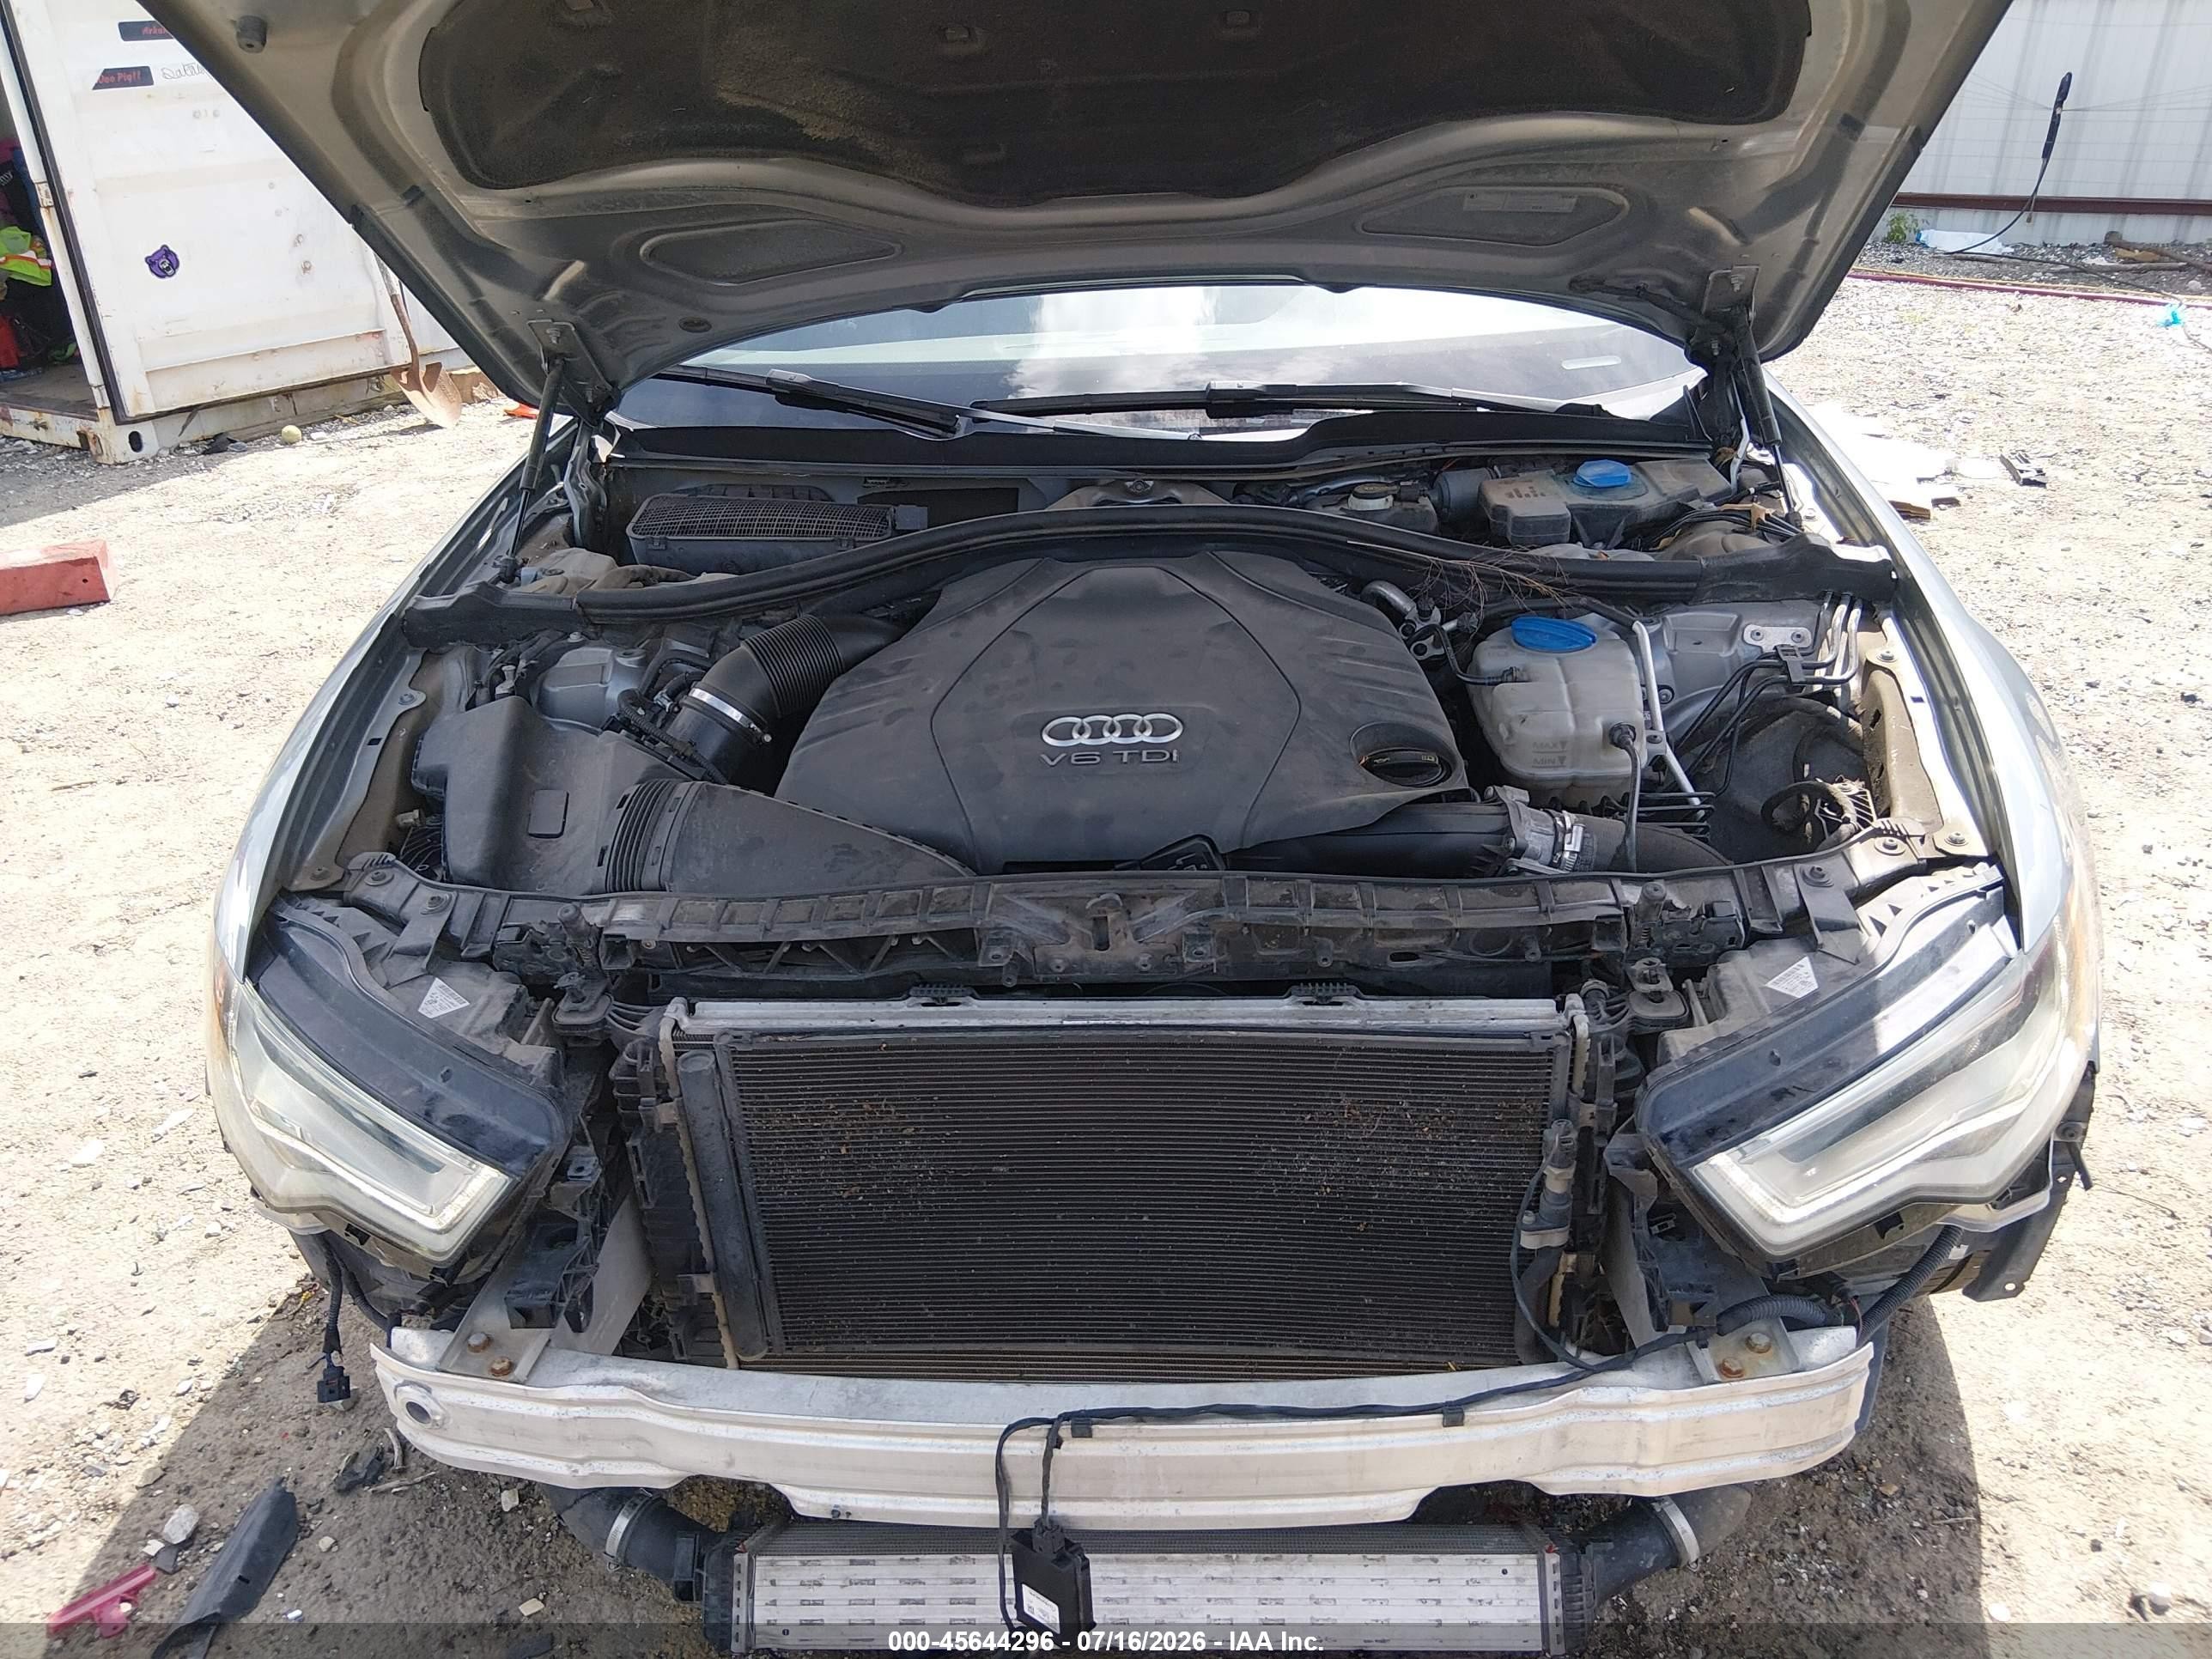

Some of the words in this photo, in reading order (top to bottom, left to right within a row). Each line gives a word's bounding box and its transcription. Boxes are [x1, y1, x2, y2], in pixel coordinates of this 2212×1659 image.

[1040, 751, 1100, 766] V6
[1113, 749, 1179, 763] TDI
[1532, 756, 1557, 765] MIN
